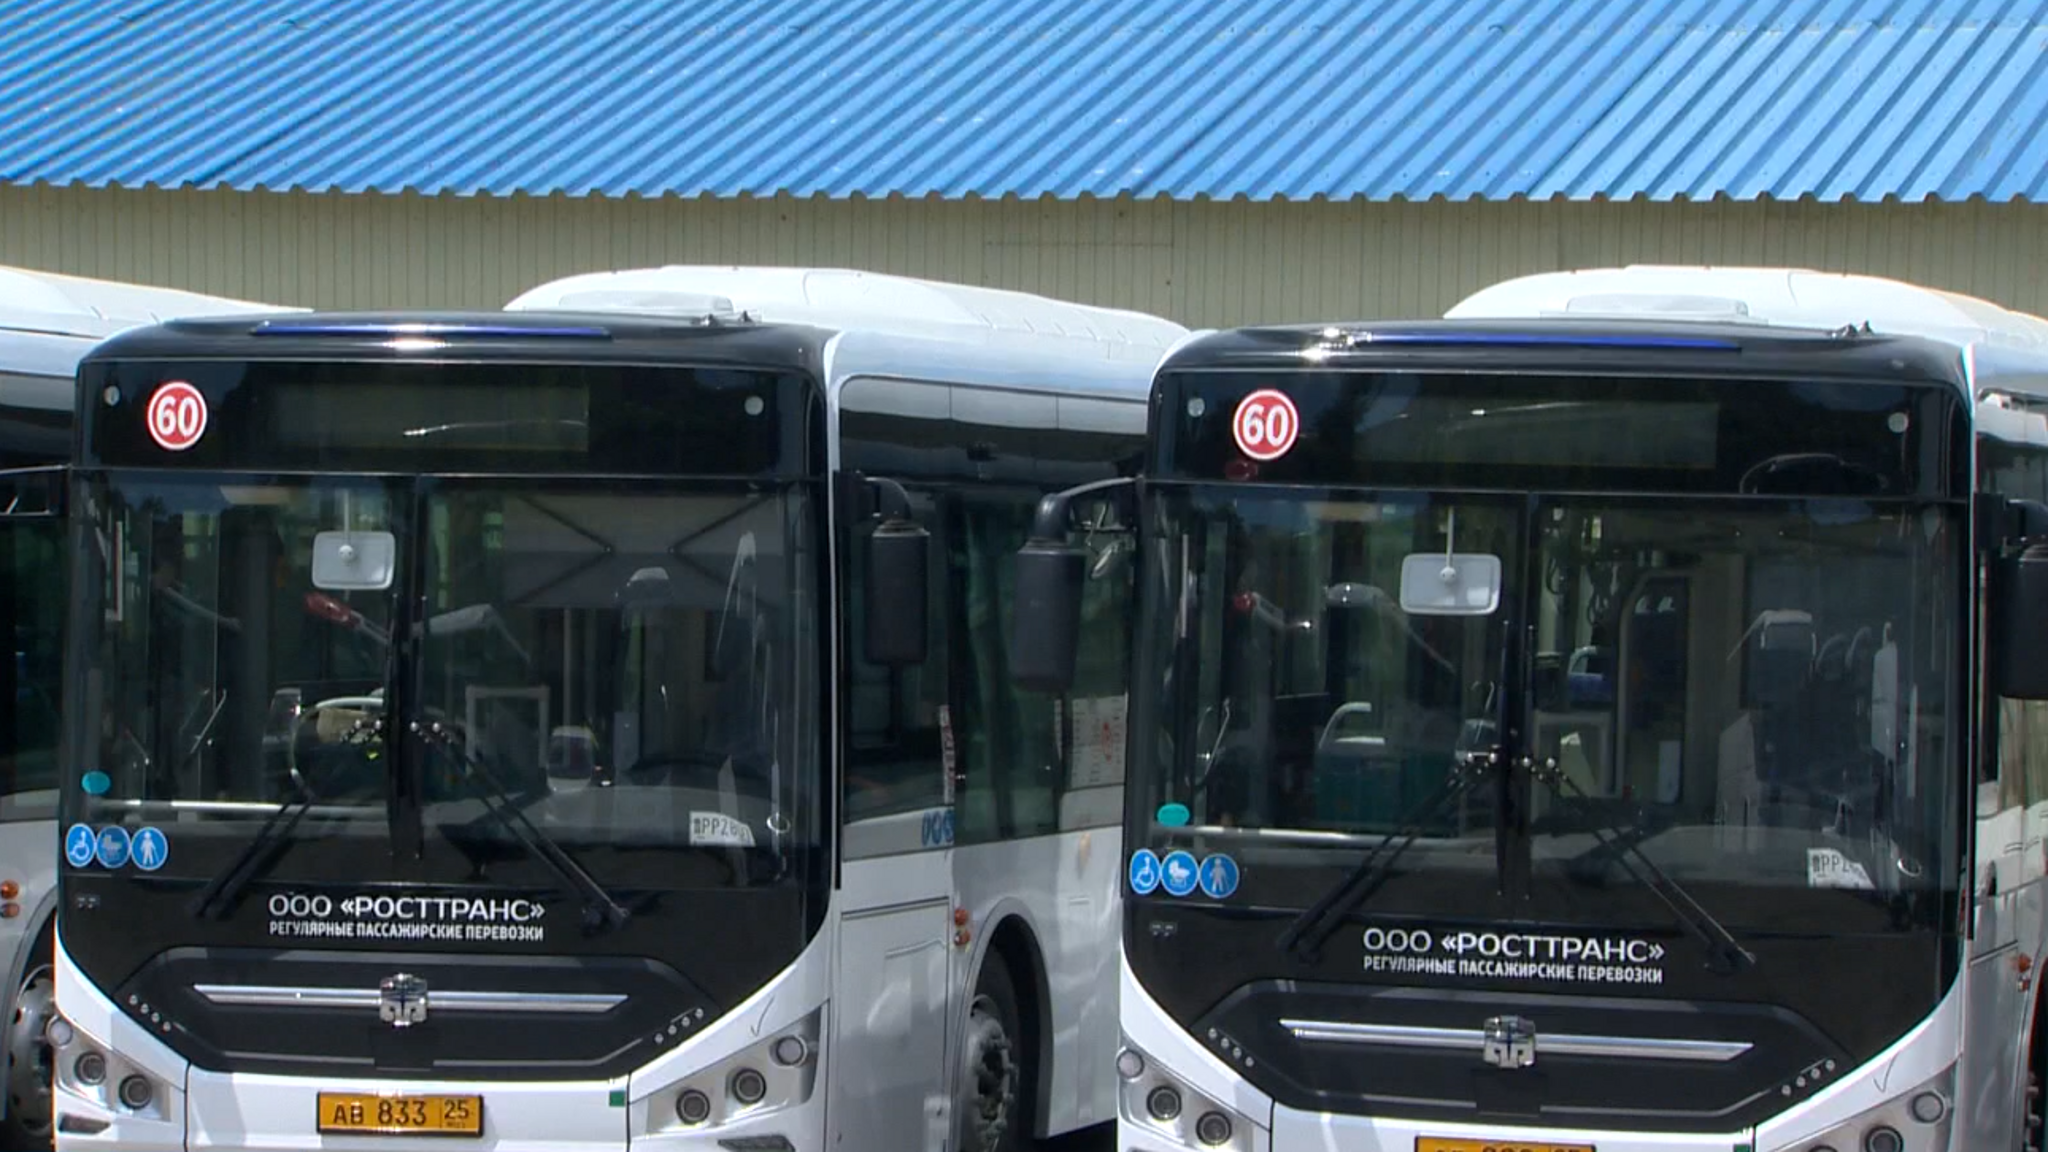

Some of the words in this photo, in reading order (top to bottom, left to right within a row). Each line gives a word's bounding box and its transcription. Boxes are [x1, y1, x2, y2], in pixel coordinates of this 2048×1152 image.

[156, 395, 199, 436] 60
[1242, 403, 1289, 447] 60
[268, 894, 332, 917] ООО
[340, 896, 545, 921] «РОСТТРАНС»
[269, 921, 354, 936] РЕГУЛЯРНЫЕ
[356, 922, 463, 939] ПАССАЖИРСКИЕ
[465, 924, 544, 941] ПЕРЕВОЗКИ
[1363, 928, 1432, 952] ООО
[1441, 932, 1665, 962] «РОСТТРАНС»
[1363, 955, 1456, 974] РЕГУЛЯРНЫЕ
[1459, 960, 1575, 980] ПАССАЖИРСКИЕ
[1578, 966, 1663, 984] ПЕРЕВОЗКИ
[378, 1099, 427, 1126] 833
[444, 1099, 469, 1120] 25
